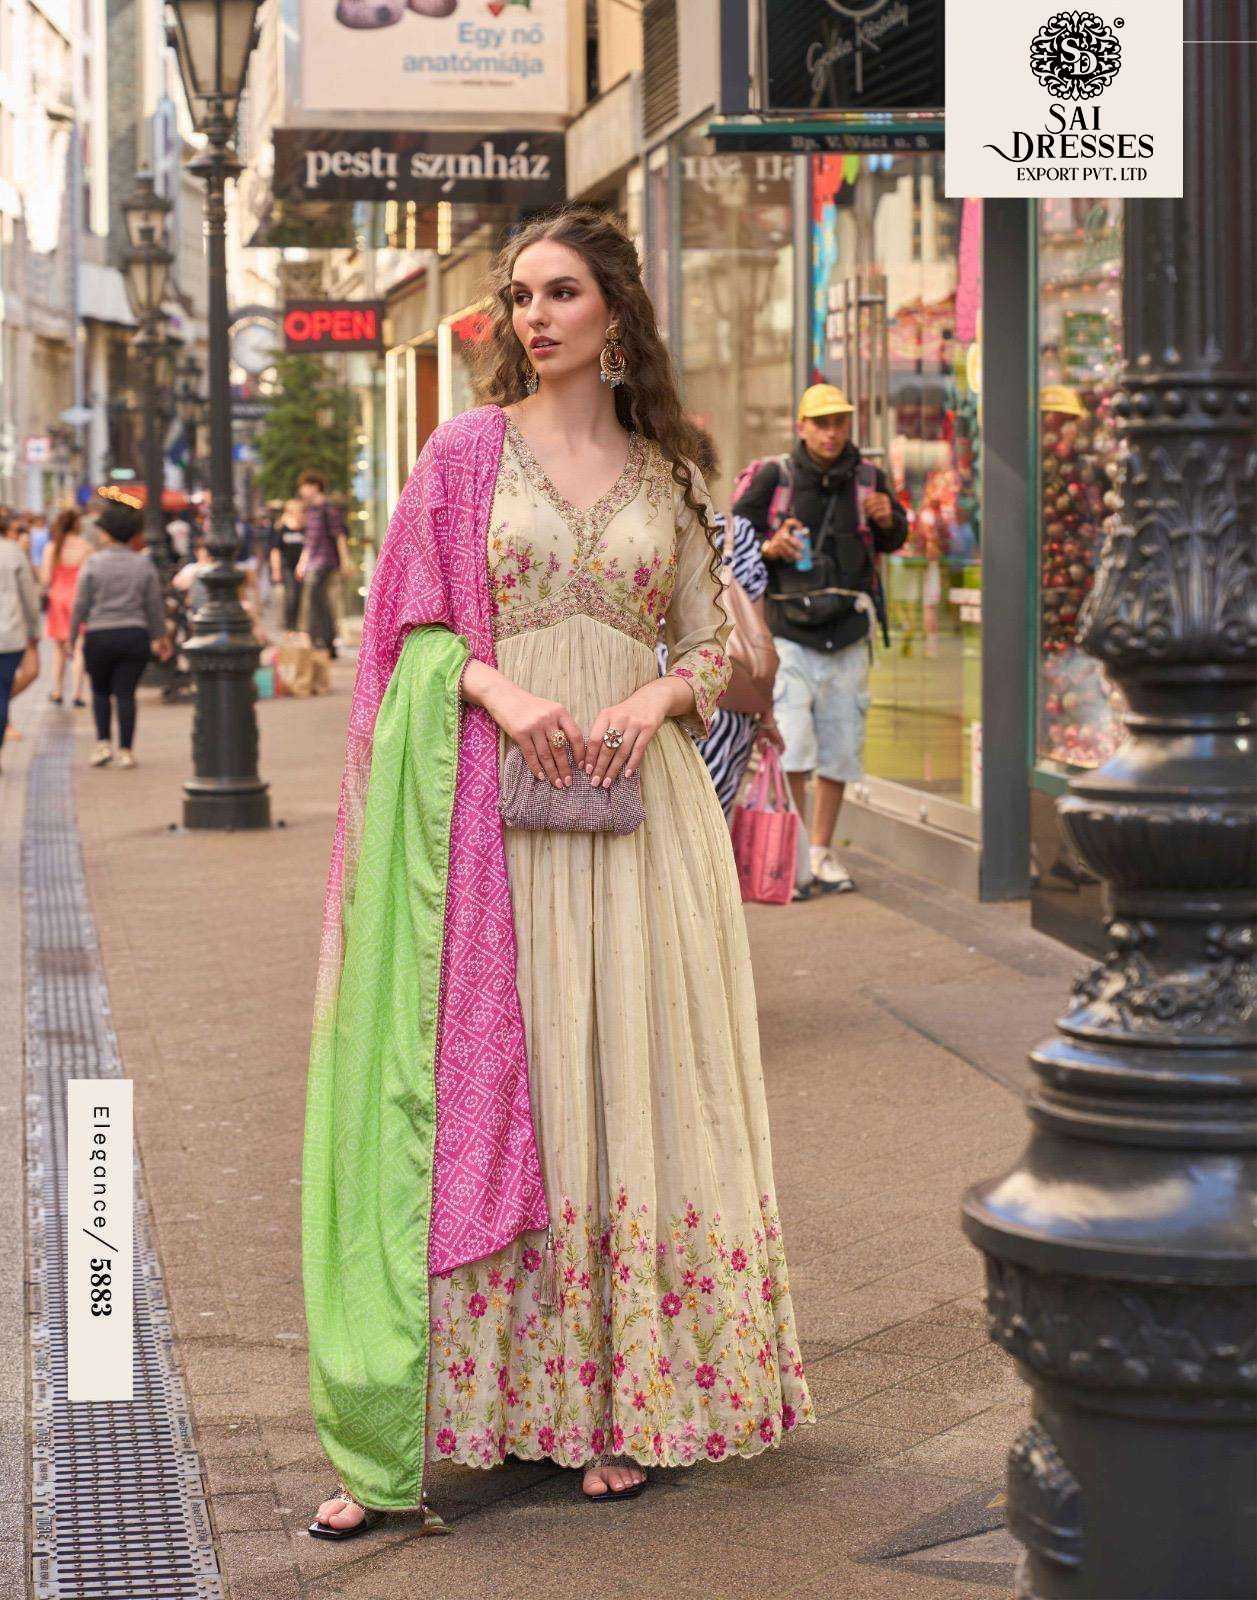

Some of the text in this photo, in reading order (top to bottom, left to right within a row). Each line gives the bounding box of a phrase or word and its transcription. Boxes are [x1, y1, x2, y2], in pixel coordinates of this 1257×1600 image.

[458, 22, 505, 49] Egy
[304, 142, 550, 193] pesti színház
[284, 310, 376, 341] OPEN
